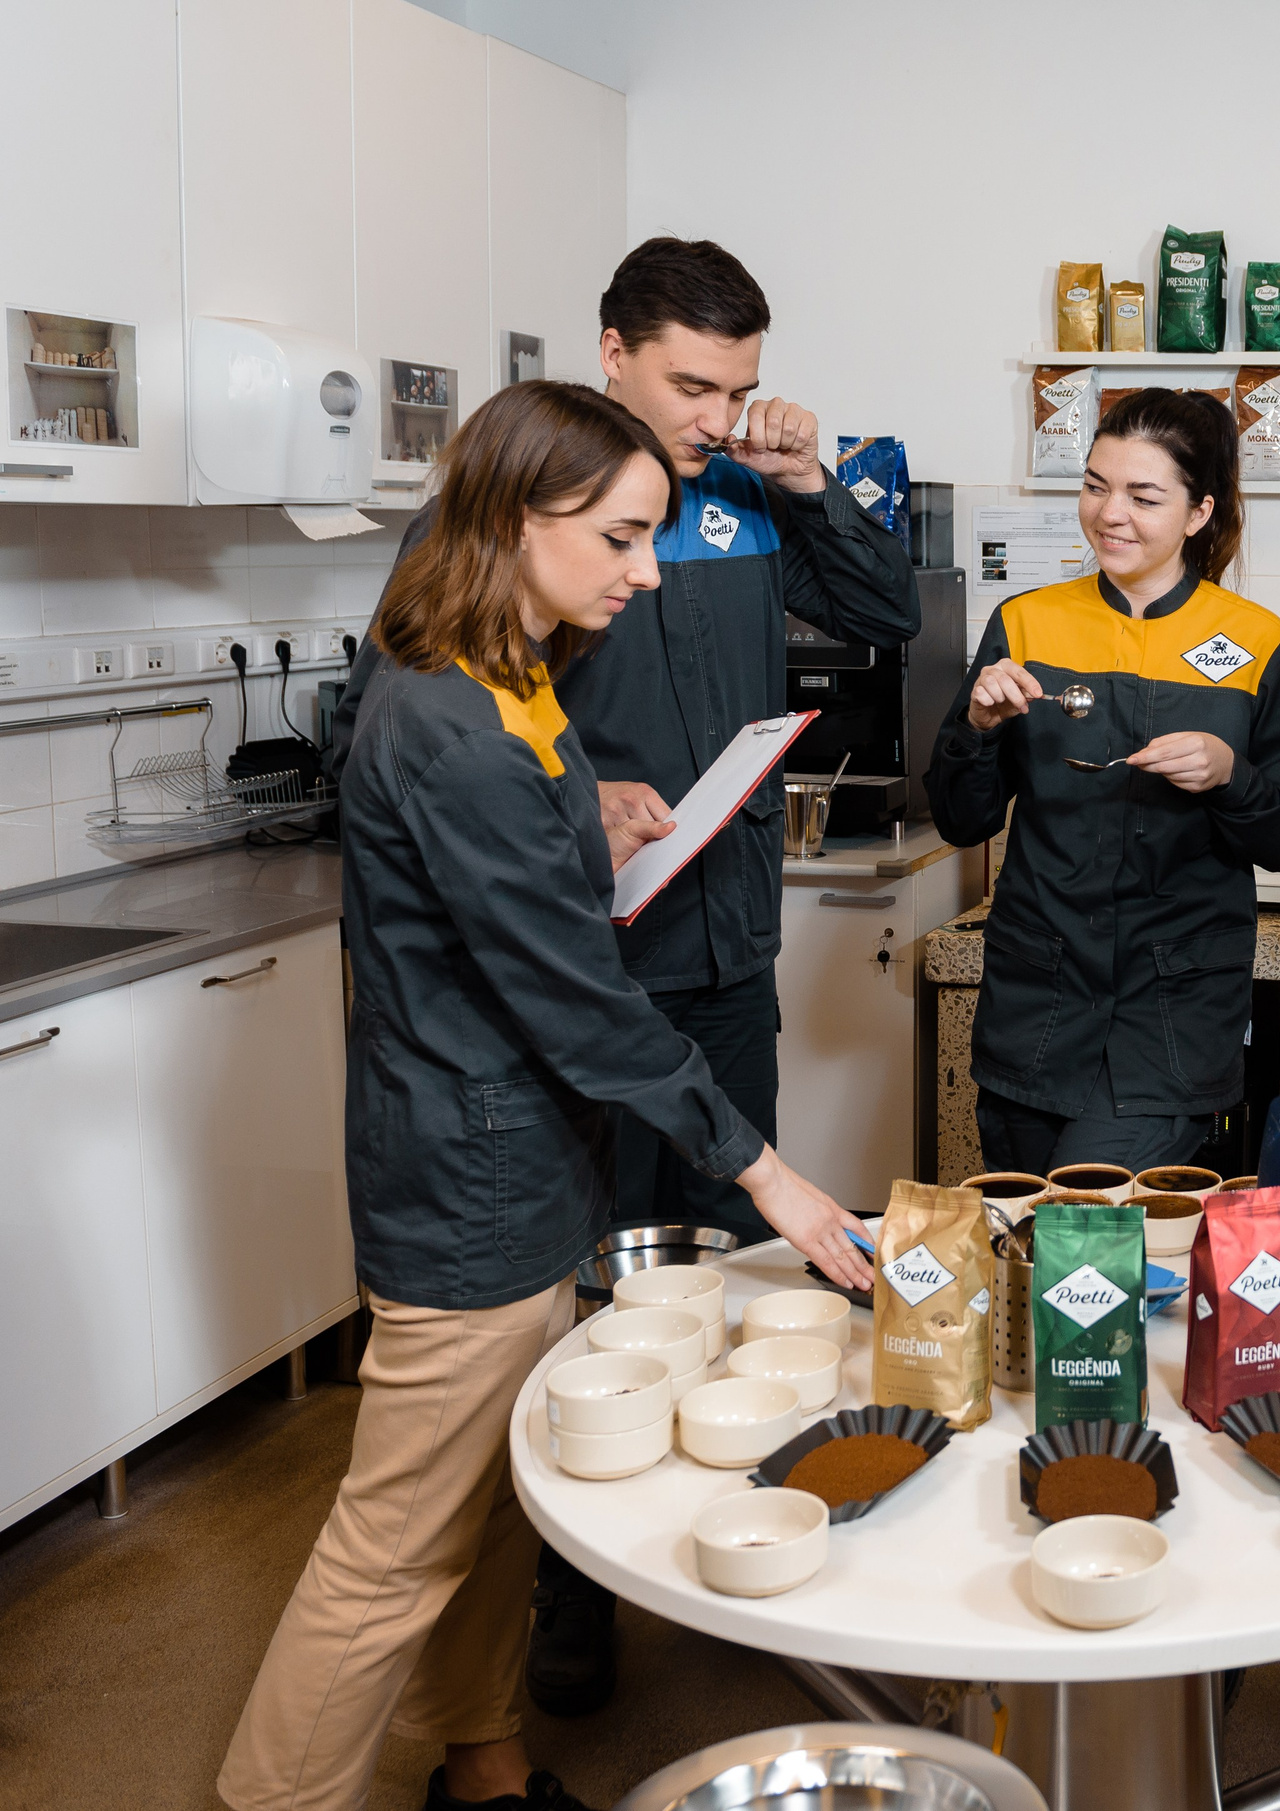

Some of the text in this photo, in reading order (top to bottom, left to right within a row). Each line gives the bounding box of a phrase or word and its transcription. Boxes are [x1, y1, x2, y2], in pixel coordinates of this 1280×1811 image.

[1166, 277, 1210, 287] PRESIDENTTI
[1045, 388, 1075, 397] Poetti
[1248, 394, 1280, 404] Poetti
[1247, 435, 1280, 443] MOKKA
[850, 488, 880, 498] Poetti
[703, 520, 735, 538] Poetti
[1194, 653, 1242, 666] Poetti
[890, 1263, 942, 1284] Poetti
[1056, 1286, 1115, 1305] Poetti
[1257, 1362, 1275, 1371] RUBY
